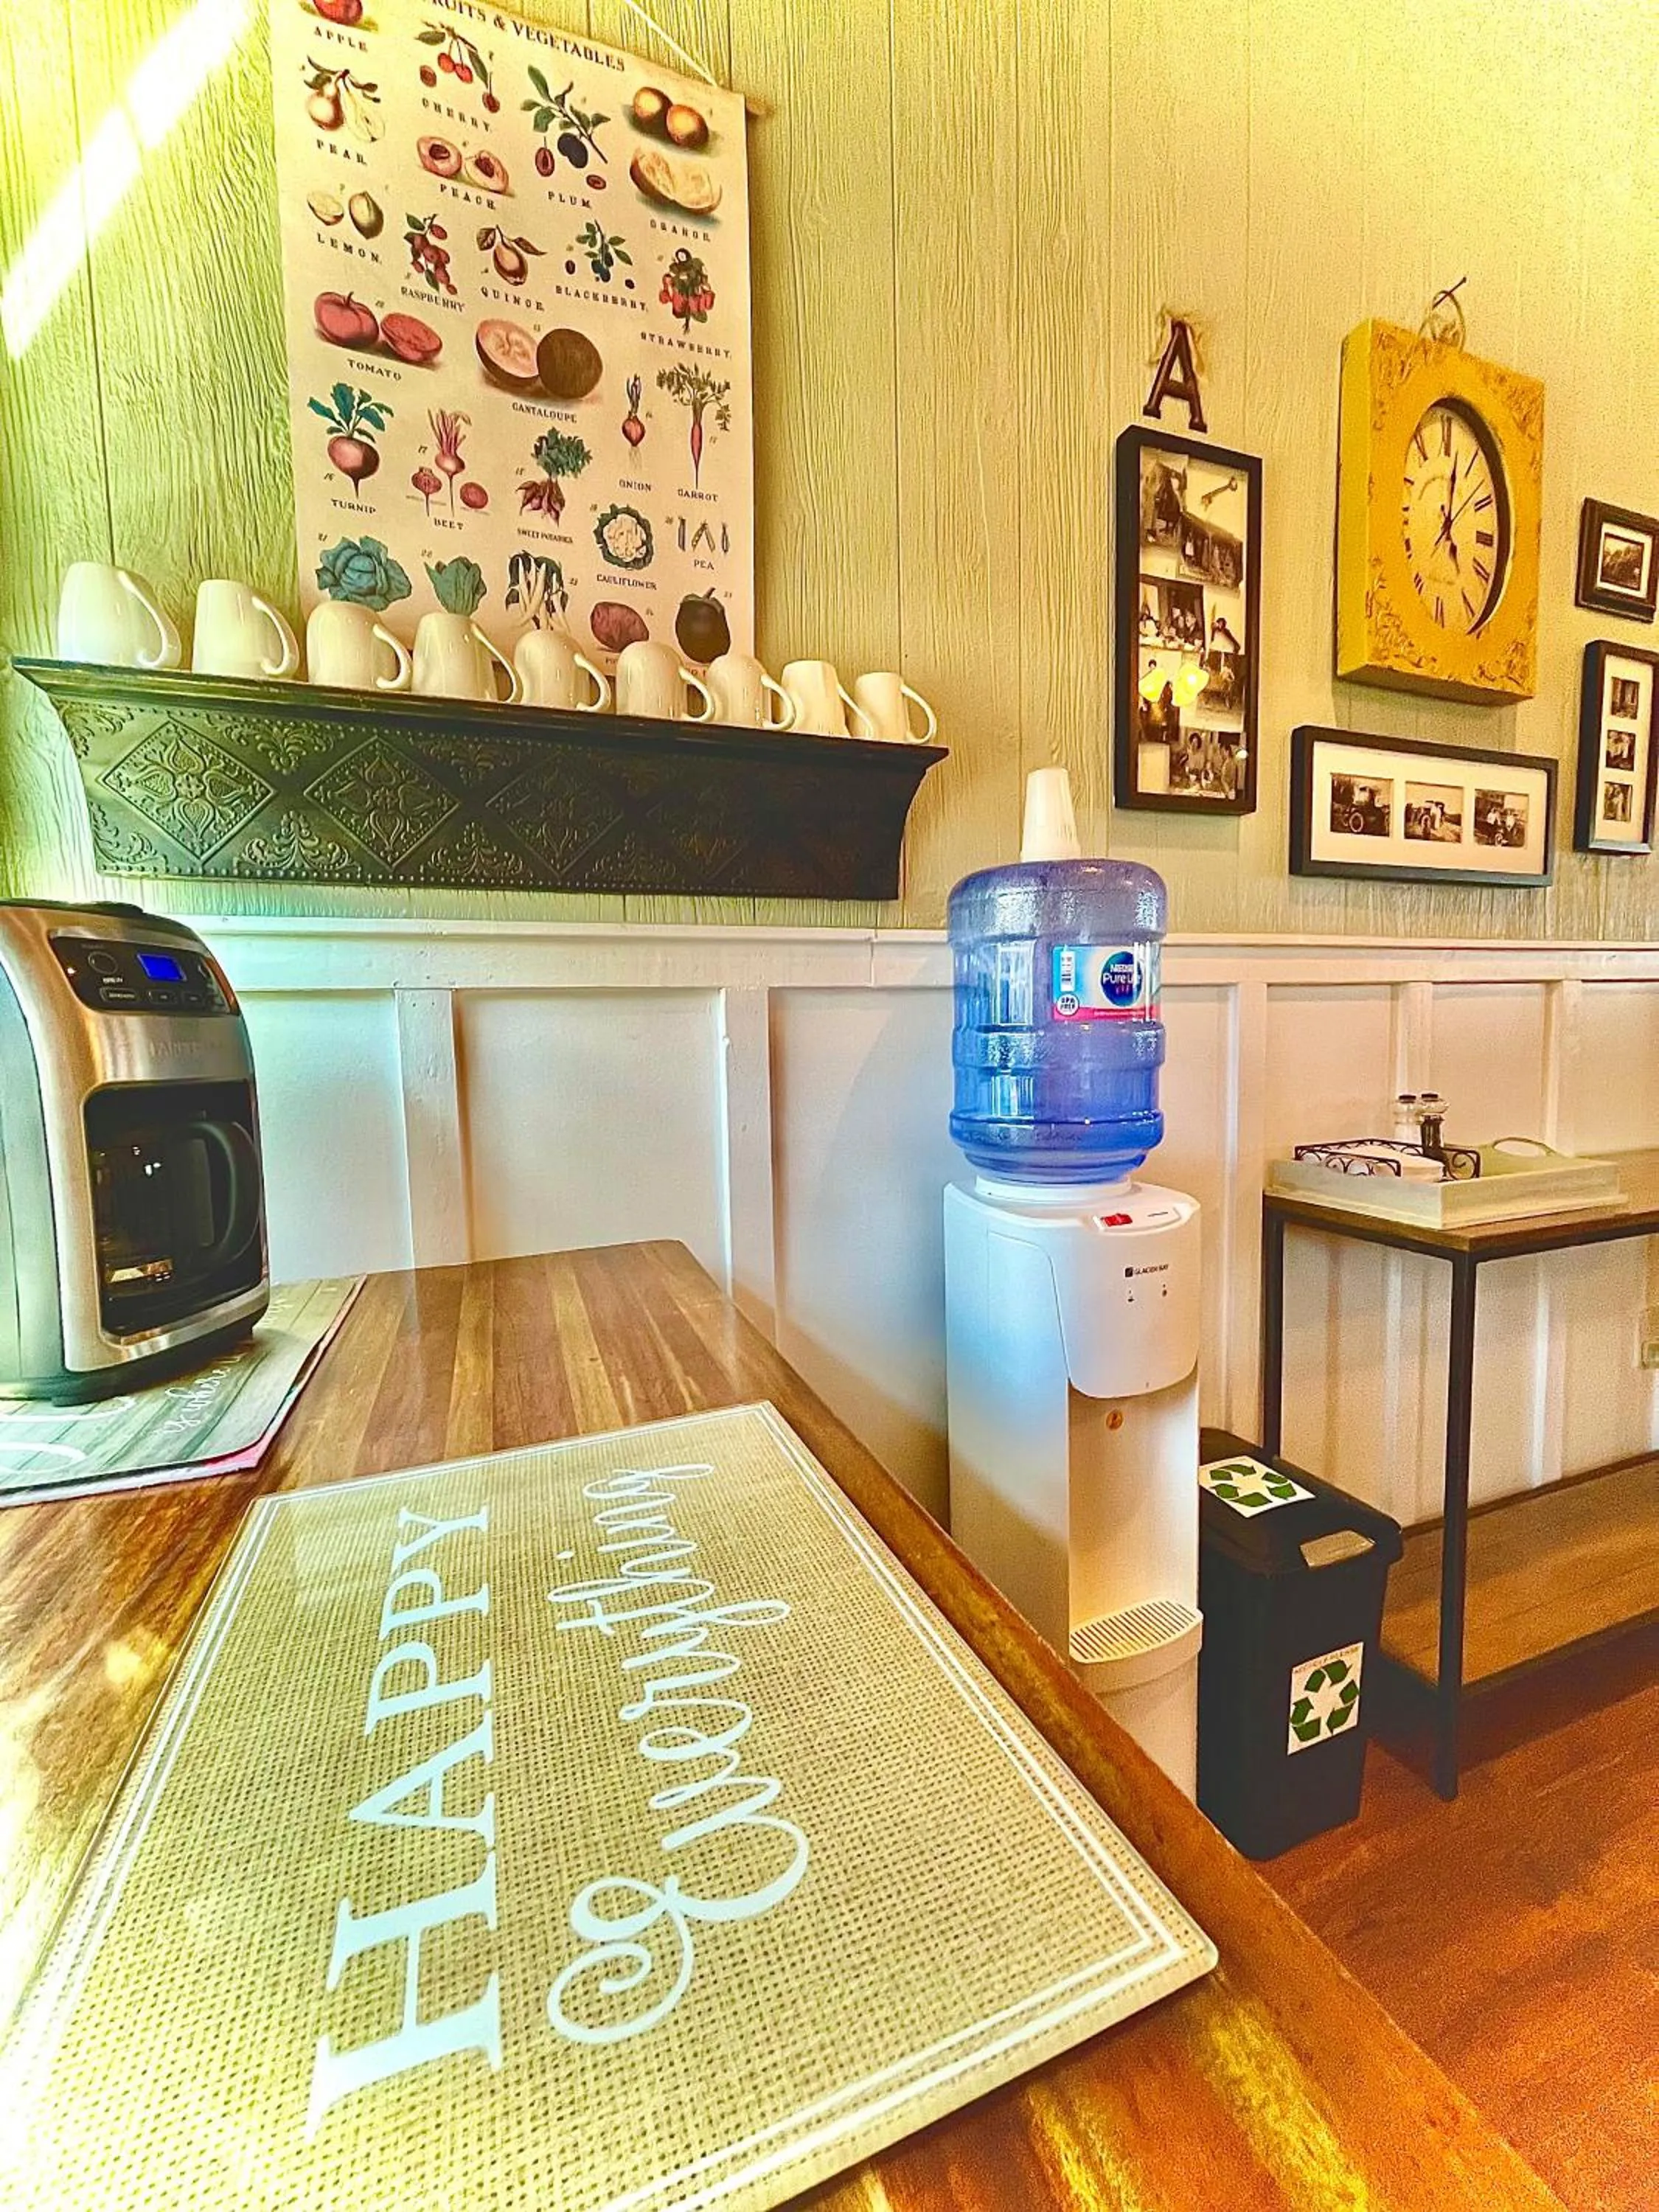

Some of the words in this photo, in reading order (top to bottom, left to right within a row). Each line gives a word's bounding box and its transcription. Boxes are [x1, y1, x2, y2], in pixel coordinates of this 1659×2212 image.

[512, 20, 625, 72] VEGETABLES
[347, 359, 402, 381] TOMATO
[619, 479, 652, 492] ONION
[677, 489, 718, 502] CARROT
[331, 499, 377, 514] TURNIP
[434, 518, 464, 530] BEET
[694, 559, 714, 571] PEA
[597, 574, 657, 591] CAULIFLOWER
[1102, 973, 1126, 984] Pure
[547, 1464, 809, 2043] Everything
[305, 1504, 502, 2143] HAPPY
